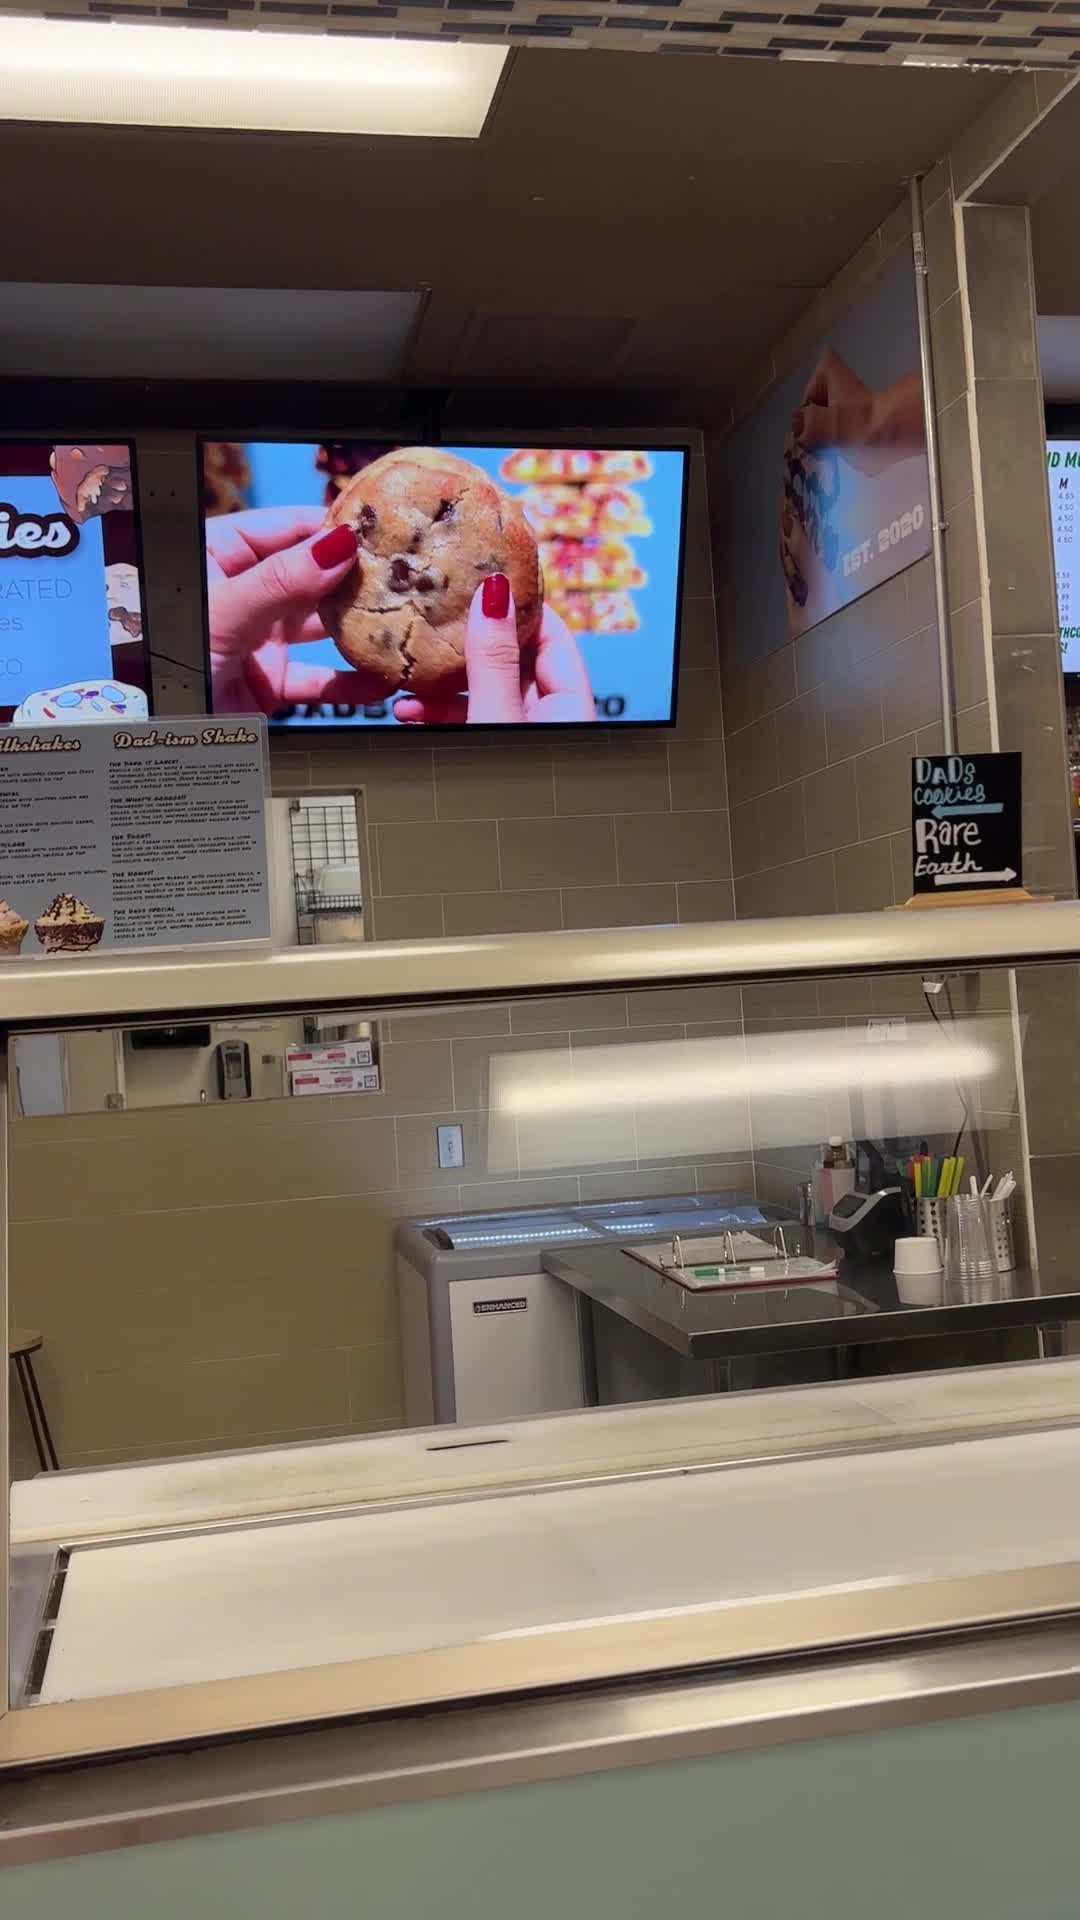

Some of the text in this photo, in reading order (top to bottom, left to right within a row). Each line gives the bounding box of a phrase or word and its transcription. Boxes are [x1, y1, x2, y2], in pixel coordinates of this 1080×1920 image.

[1047, 451, 1080, 468] D M
[879, 504, 923, 553] 2020
[114, 727, 258, 749] Dad-ism Shake
[915, 818, 982, 854] Rare
[914, 851, 983, 877] Earth
